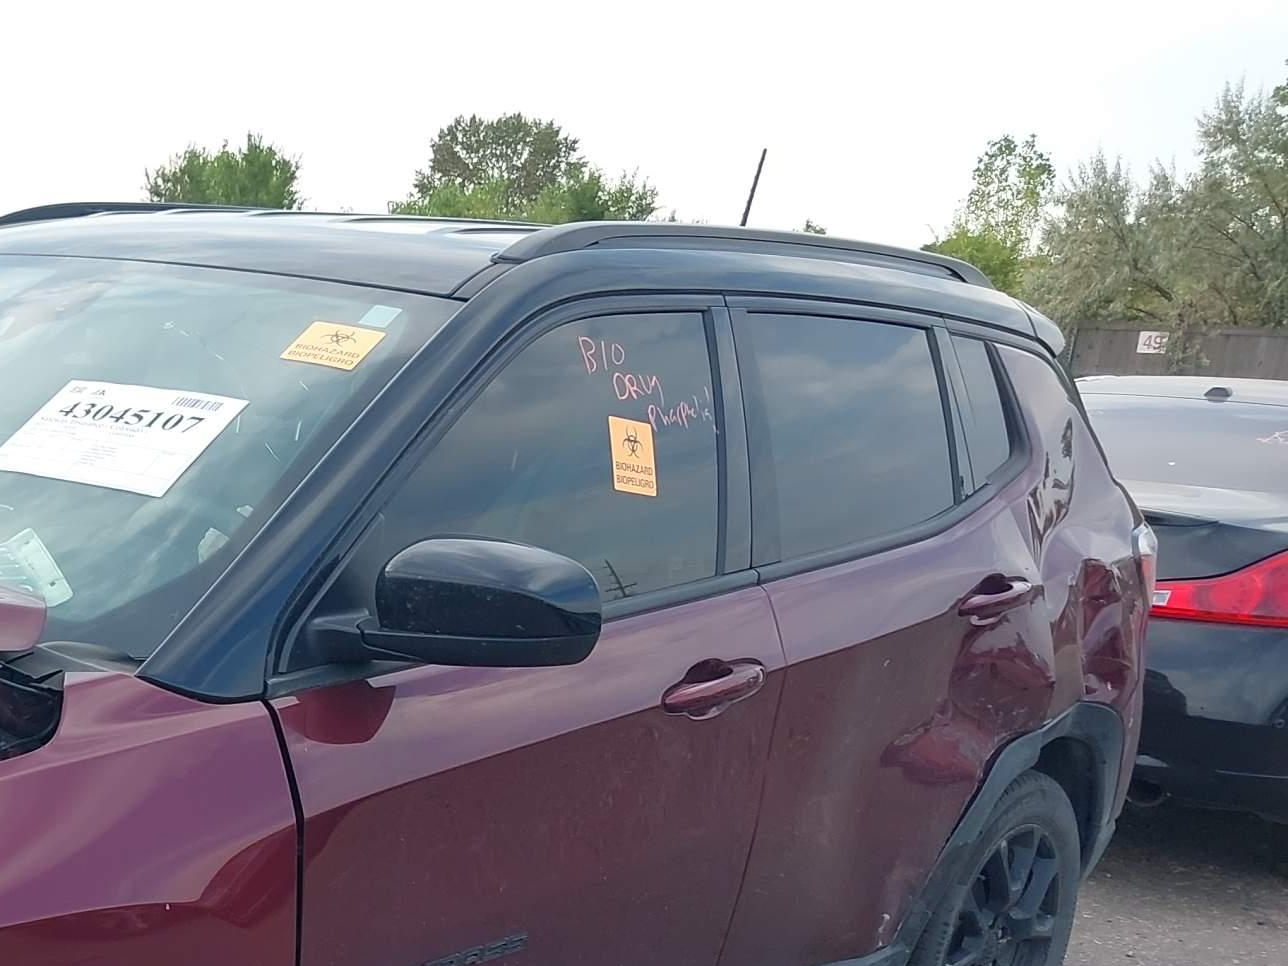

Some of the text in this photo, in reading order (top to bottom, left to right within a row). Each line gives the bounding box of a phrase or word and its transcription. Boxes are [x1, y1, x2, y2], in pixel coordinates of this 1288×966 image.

[287, 350, 354, 366] BIOPELIGRO
[295, 343, 360, 359] BIOHAZARD
[578, 336, 625, 375] BIO
[59, 401, 206, 433] 43045107
[615, 460, 653, 476] BIOHAZARD
[616, 474, 655, 489] BIOPELIGRO
